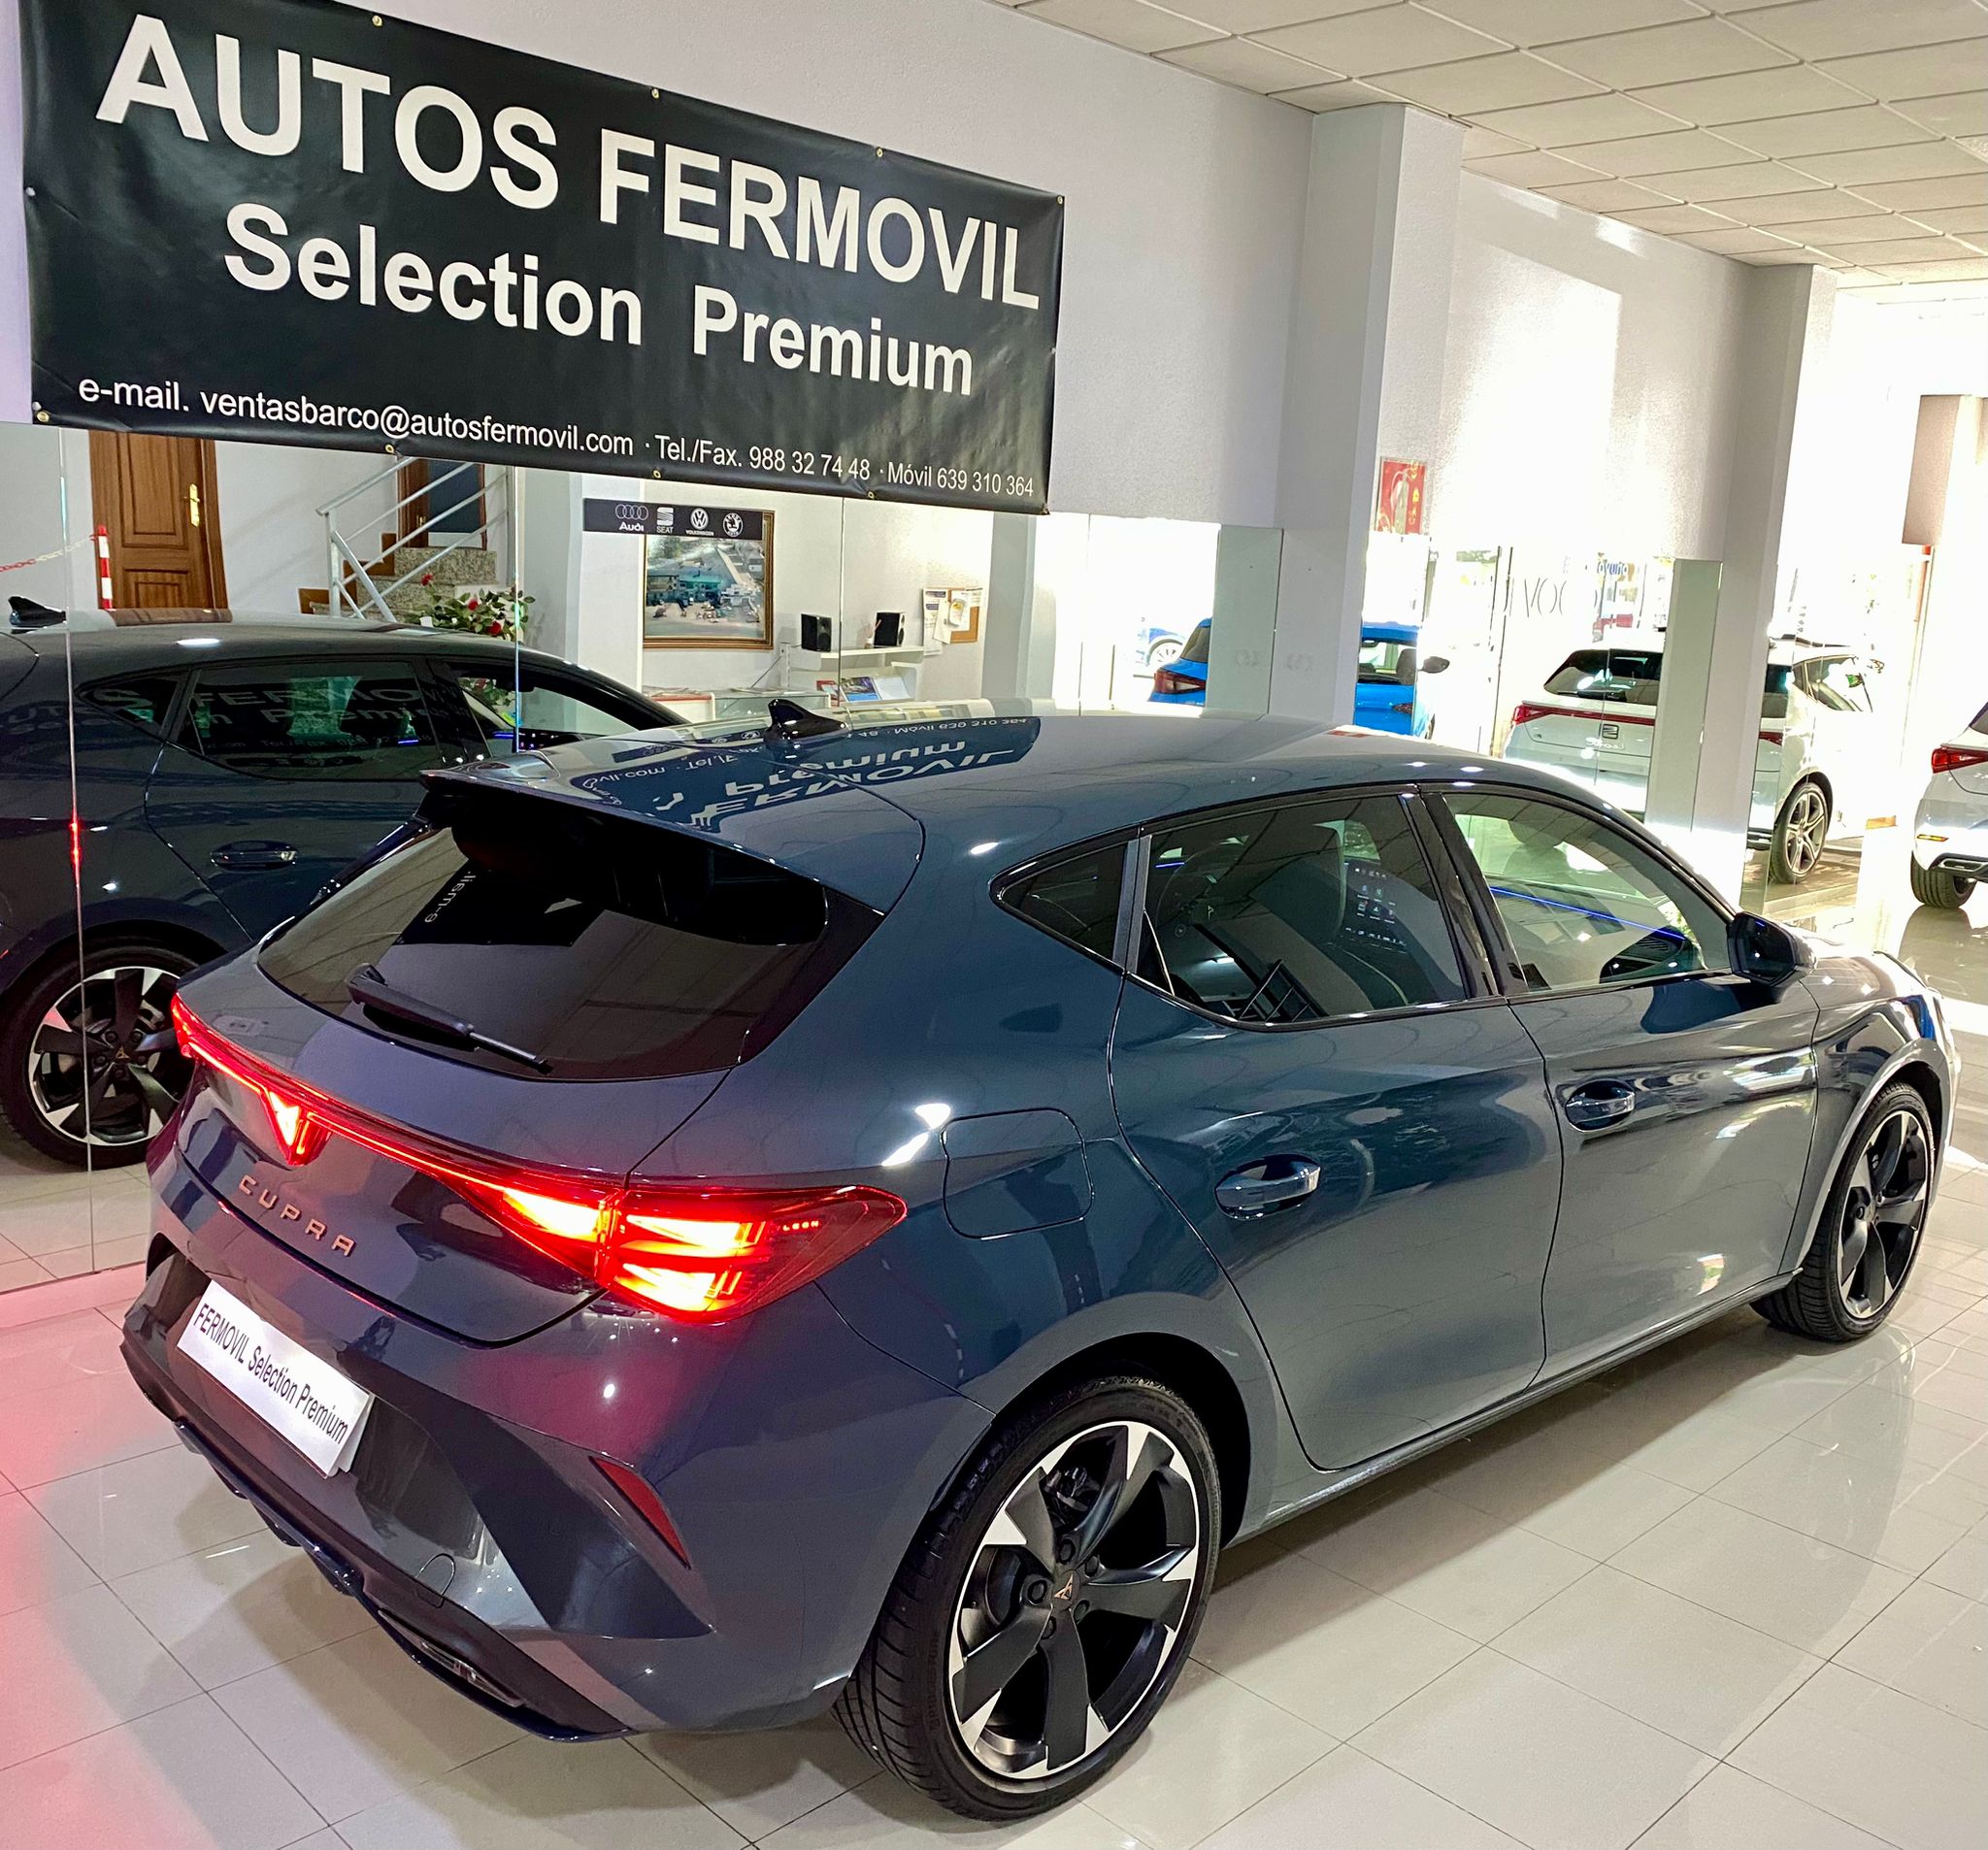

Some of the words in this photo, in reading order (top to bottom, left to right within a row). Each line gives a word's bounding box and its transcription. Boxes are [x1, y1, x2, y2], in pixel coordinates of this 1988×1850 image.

[96, 14, 559, 210] AUTOS
[601, 129, 1039, 310] FERMOVIL
[225, 204, 641, 345] Selection
[694, 285, 972, 395] Premium
[79, 379, 189, 412] e-mail.
[200, 391, 633, 455] ventasbarco@autosfermovil.com
[749, 446, 785, 472] 988
[791, 451, 814, 475] 32
[821, 454, 843, 478] 74
[848, 458, 870, 479] 48
[888, 462, 931, 486] Móvil
[937, 468, 967, 490] 639
[973, 472, 1001, 493] 310
[1006, 476, 1033, 497] 364
[619, 522, 645, 532] Audi
[656, 525, 674, 534] SEAT
[239, 1174, 355, 1257] CUPRA
[193, 1303, 249, 1364] FERMOVIL
[248, 1345, 298, 1404] Selection
[294, 1383, 348, 1444] Premium
